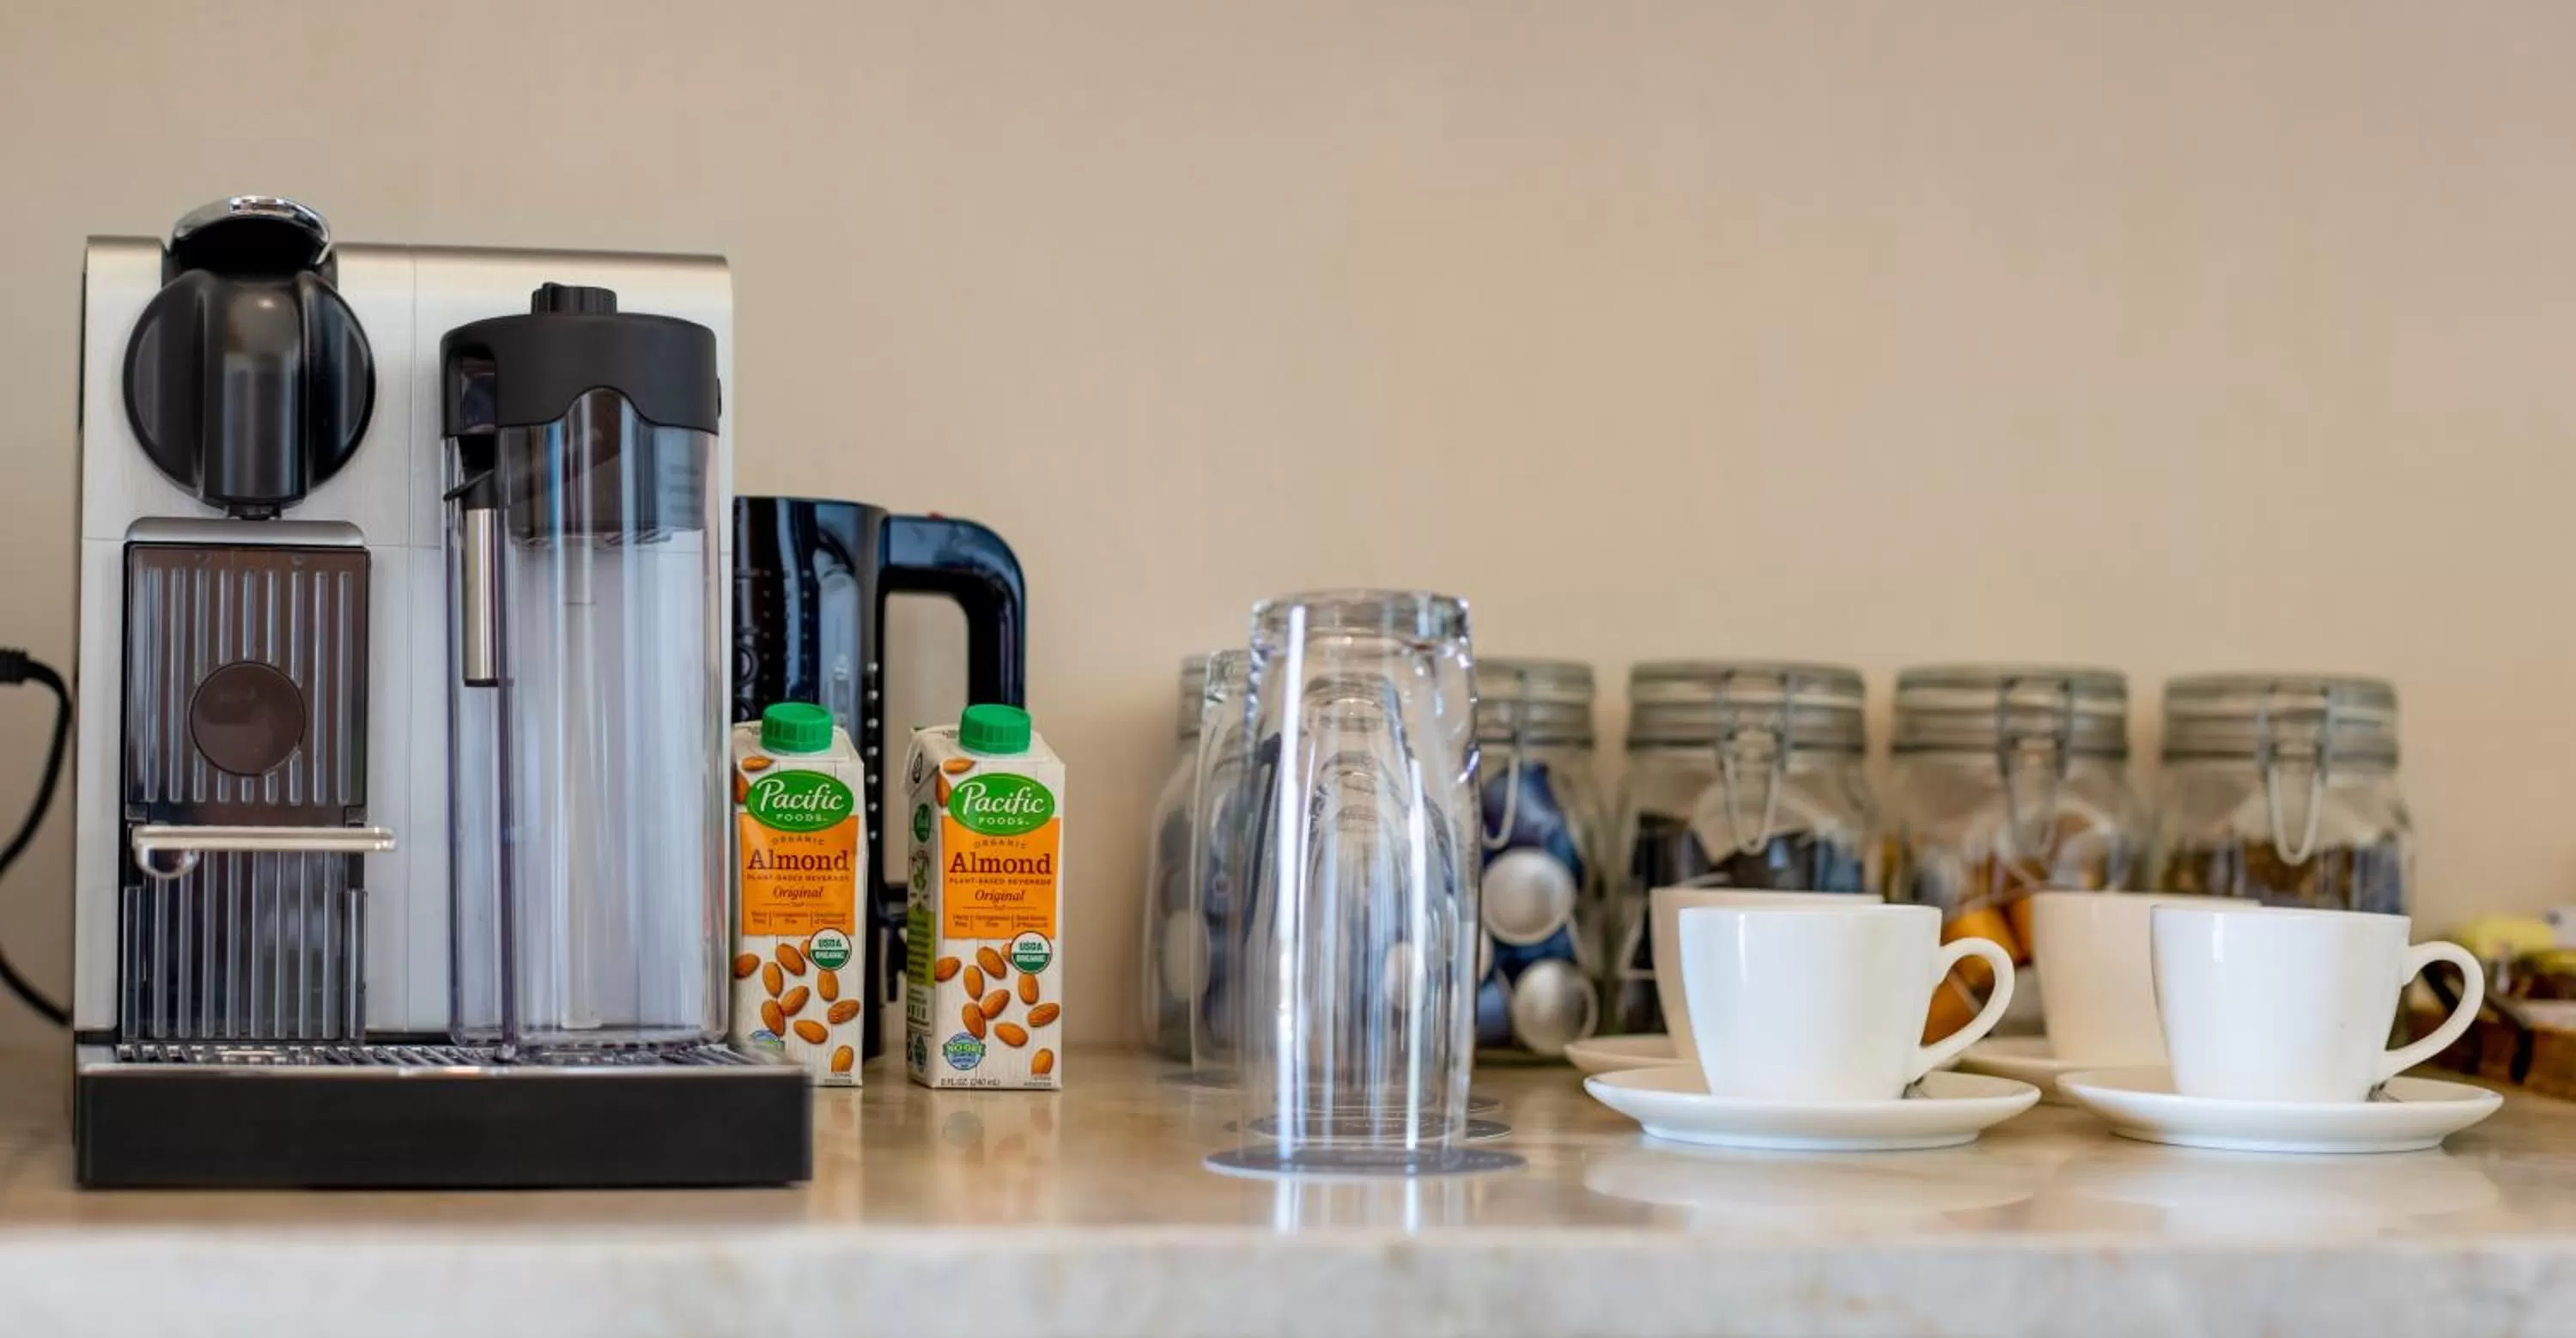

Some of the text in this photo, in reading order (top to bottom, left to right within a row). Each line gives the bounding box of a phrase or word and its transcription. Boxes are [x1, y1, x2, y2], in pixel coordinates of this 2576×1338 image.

[756, 779, 844, 812] Pacific
[958, 782, 1045, 815] Pacific
[978, 817, 1024, 825] FOODS
[746, 848, 850, 871] Almond
[949, 852, 1052, 874] Almond
[773, 885, 824, 900] Original
[975, 889, 1026, 903] Original
[1019, 942, 1043, 951] USDA
